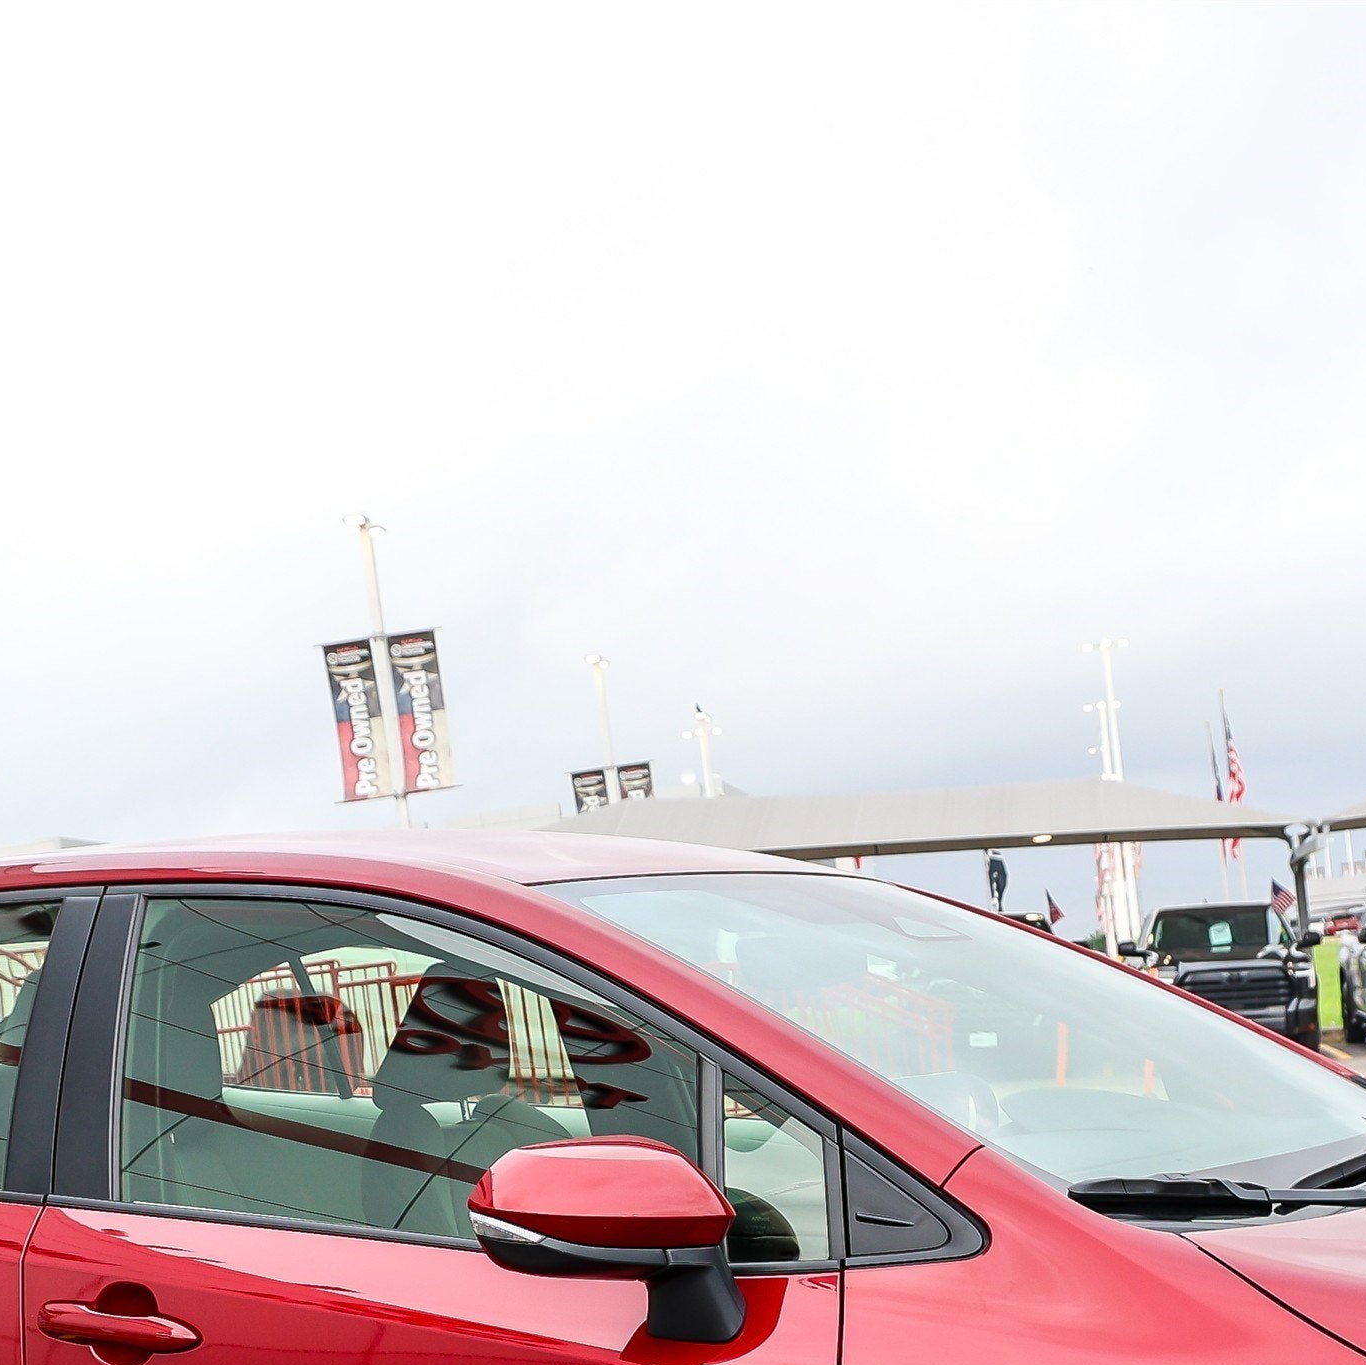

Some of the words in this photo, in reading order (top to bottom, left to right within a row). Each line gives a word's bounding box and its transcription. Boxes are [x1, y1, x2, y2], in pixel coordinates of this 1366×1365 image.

[340, 677, 374, 757] Owned
[403, 669, 437, 750] Owned
[355, 757, 380, 797] Pre
[416, 750, 441, 789] Pre
